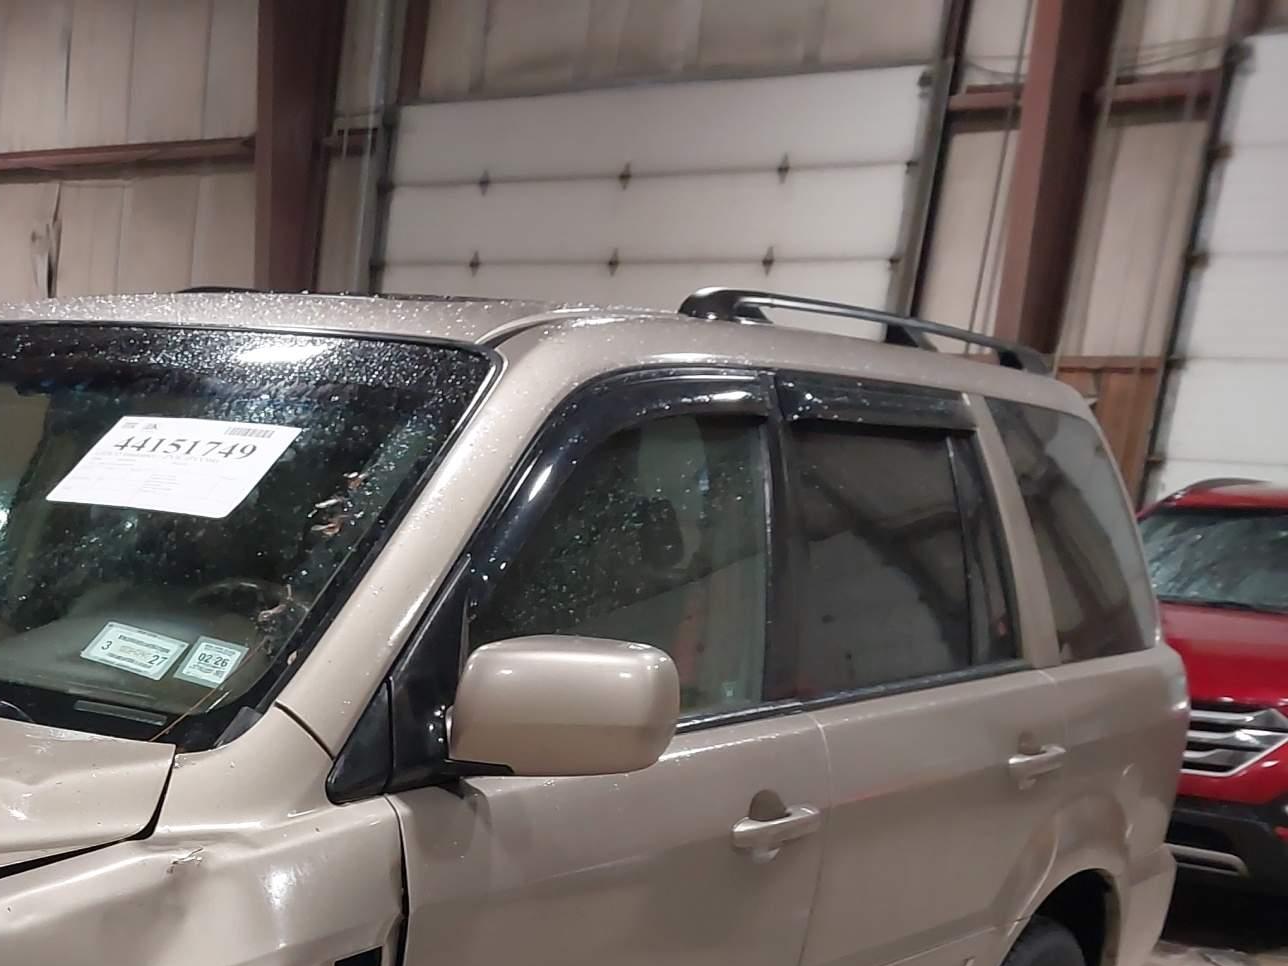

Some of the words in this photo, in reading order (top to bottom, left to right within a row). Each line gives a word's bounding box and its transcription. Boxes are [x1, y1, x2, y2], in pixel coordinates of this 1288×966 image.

[114, 436, 257, 459] 44151749
[100, 640, 113, 651] 3
[148, 654, 169, 666] 27
[198, 652, 213, 664] 02
[214, 656, 230, 668] 26
